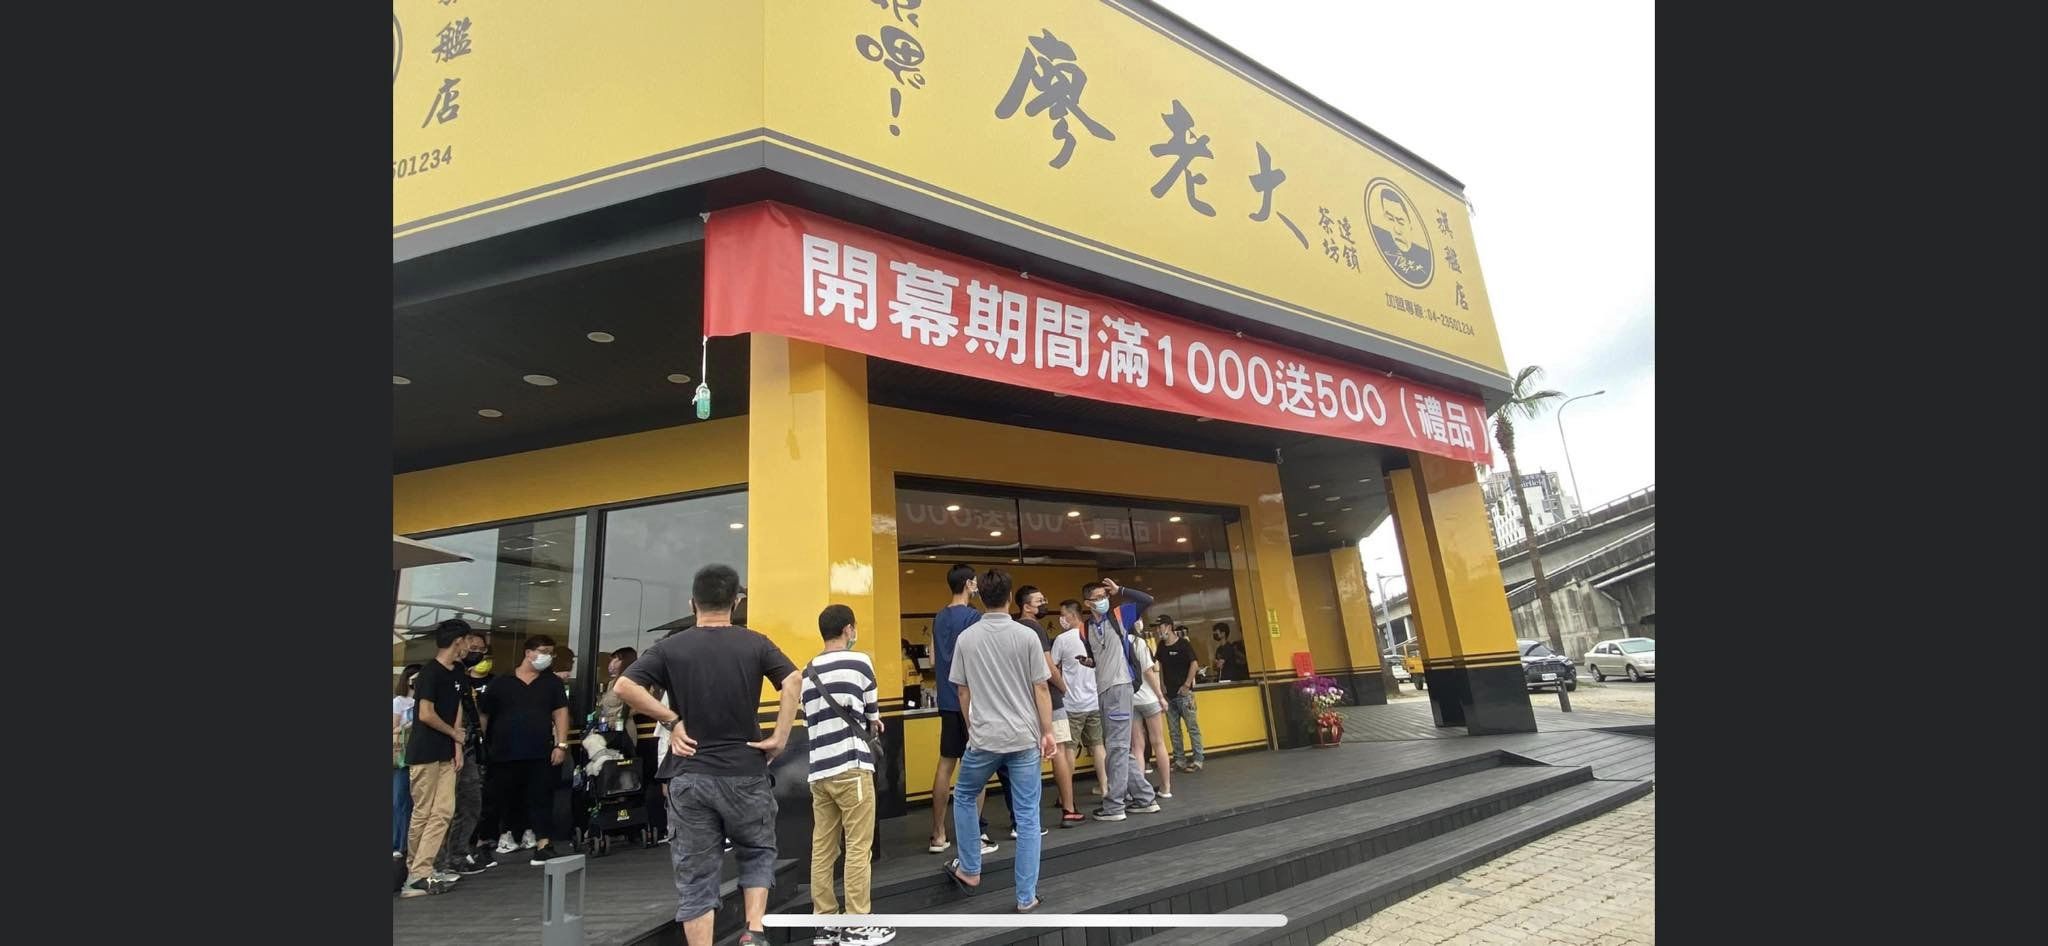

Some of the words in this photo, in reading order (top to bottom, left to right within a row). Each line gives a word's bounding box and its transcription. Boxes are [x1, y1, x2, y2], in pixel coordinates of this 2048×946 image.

[421, 0, 473, 129] 艦店
[995, 28, 1309, 250] 廖老大
